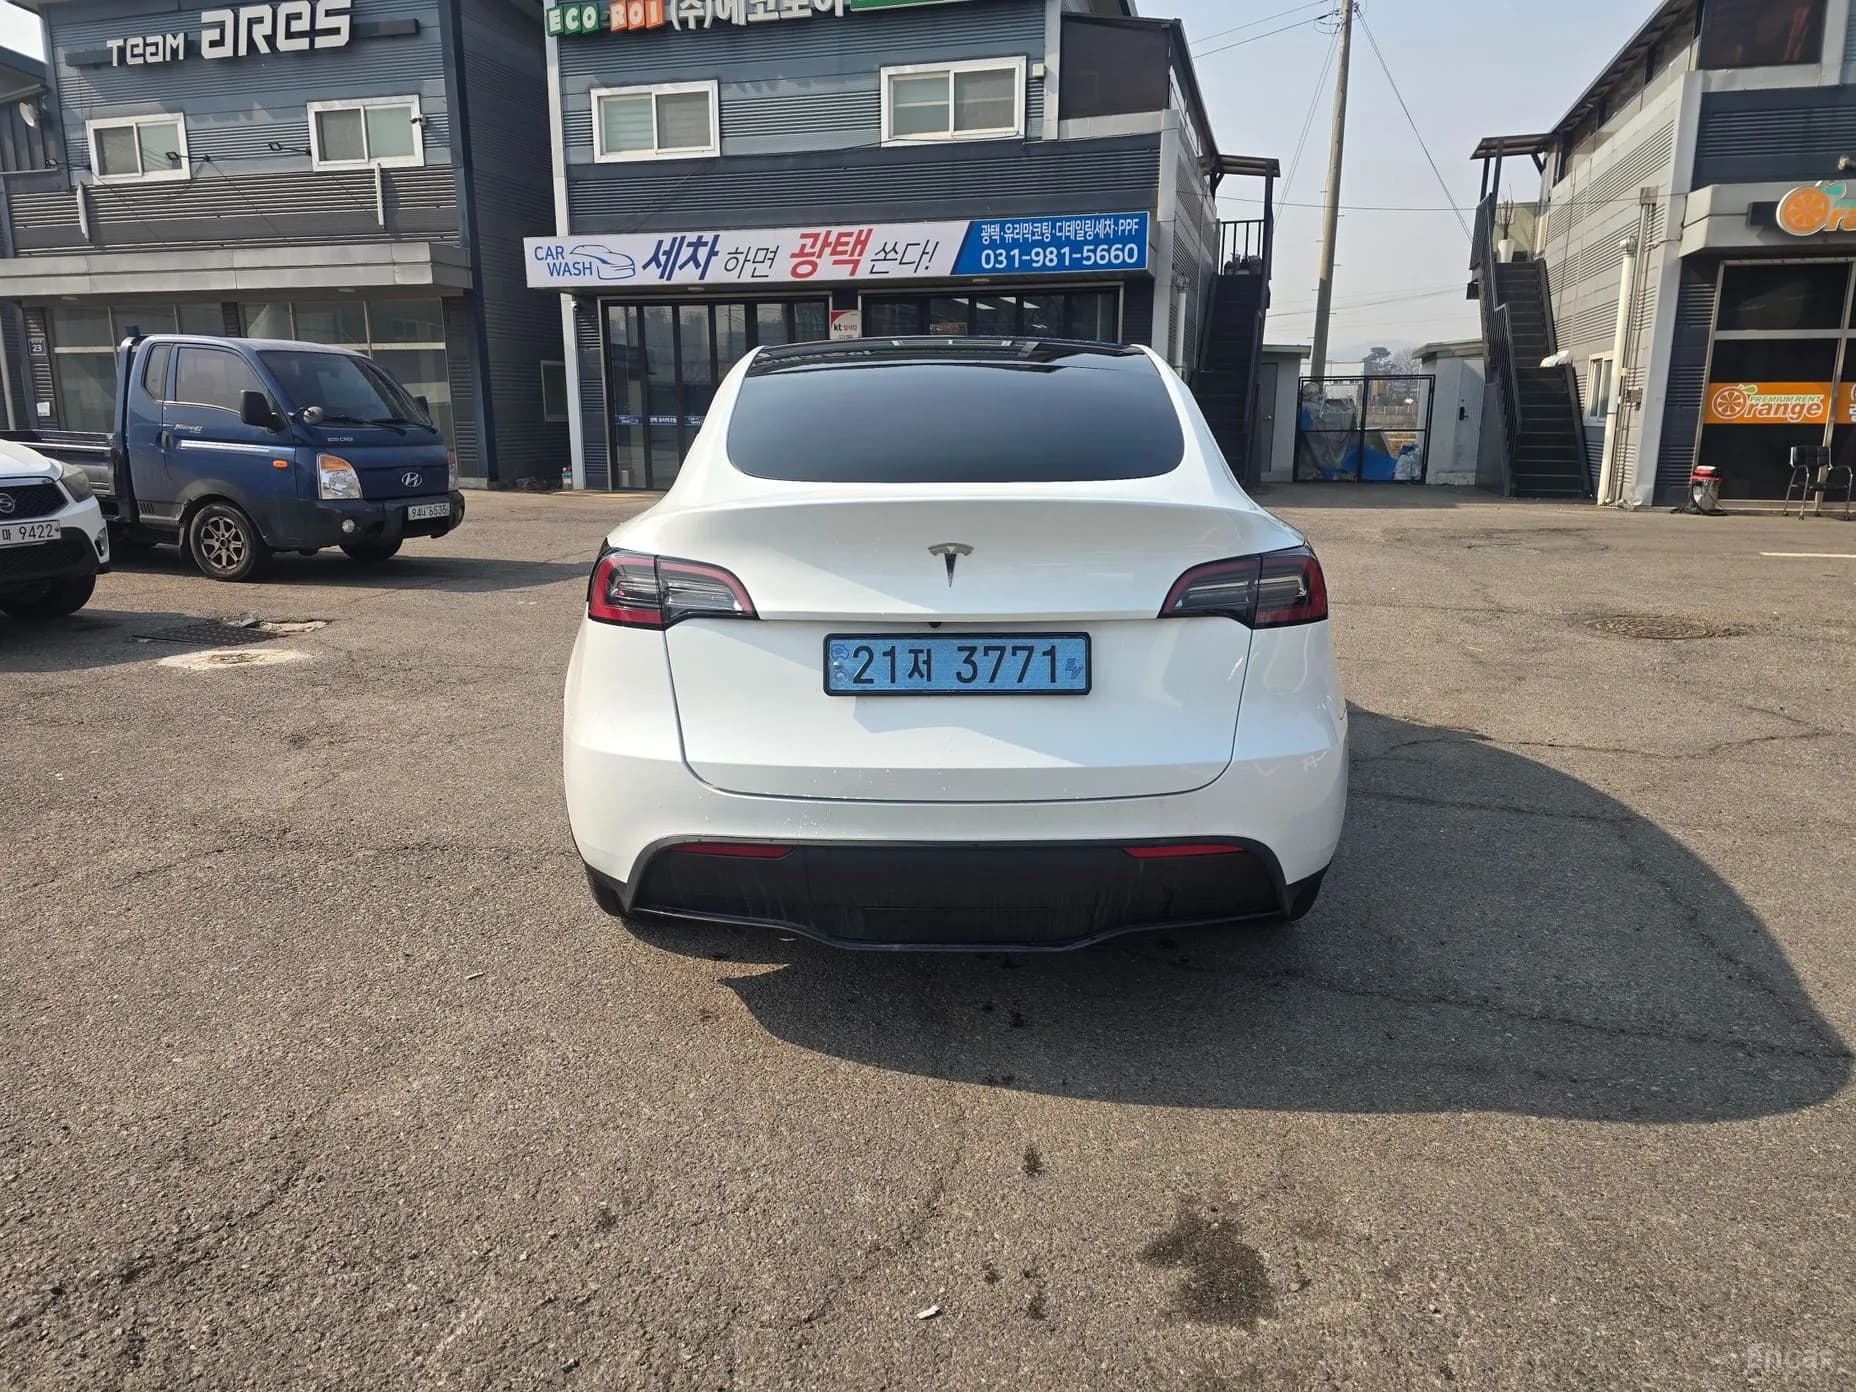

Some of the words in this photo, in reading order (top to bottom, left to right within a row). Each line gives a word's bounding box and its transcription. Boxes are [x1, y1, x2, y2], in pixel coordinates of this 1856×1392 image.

[548, 6, 598, 34] ECO
[610, 0, 660, 30] ROI
[534, 245, 565, 261] CAR
[641, 234, 721, 281] 세차
[724, 245, 779, 279] 하면
[789, 228, 873, 279] 광택
[869, 239, 940, 275] 쏜다!
[981, 243, 1139, 269] 031-981-5660
[546, 261, 593, 277] WASH
[32, 344, 42, 352] 23
[19, 523, 54, 540] 9422
[852, 645, 932, 684] 21저
[956, 645, 1057, 684] 3771
